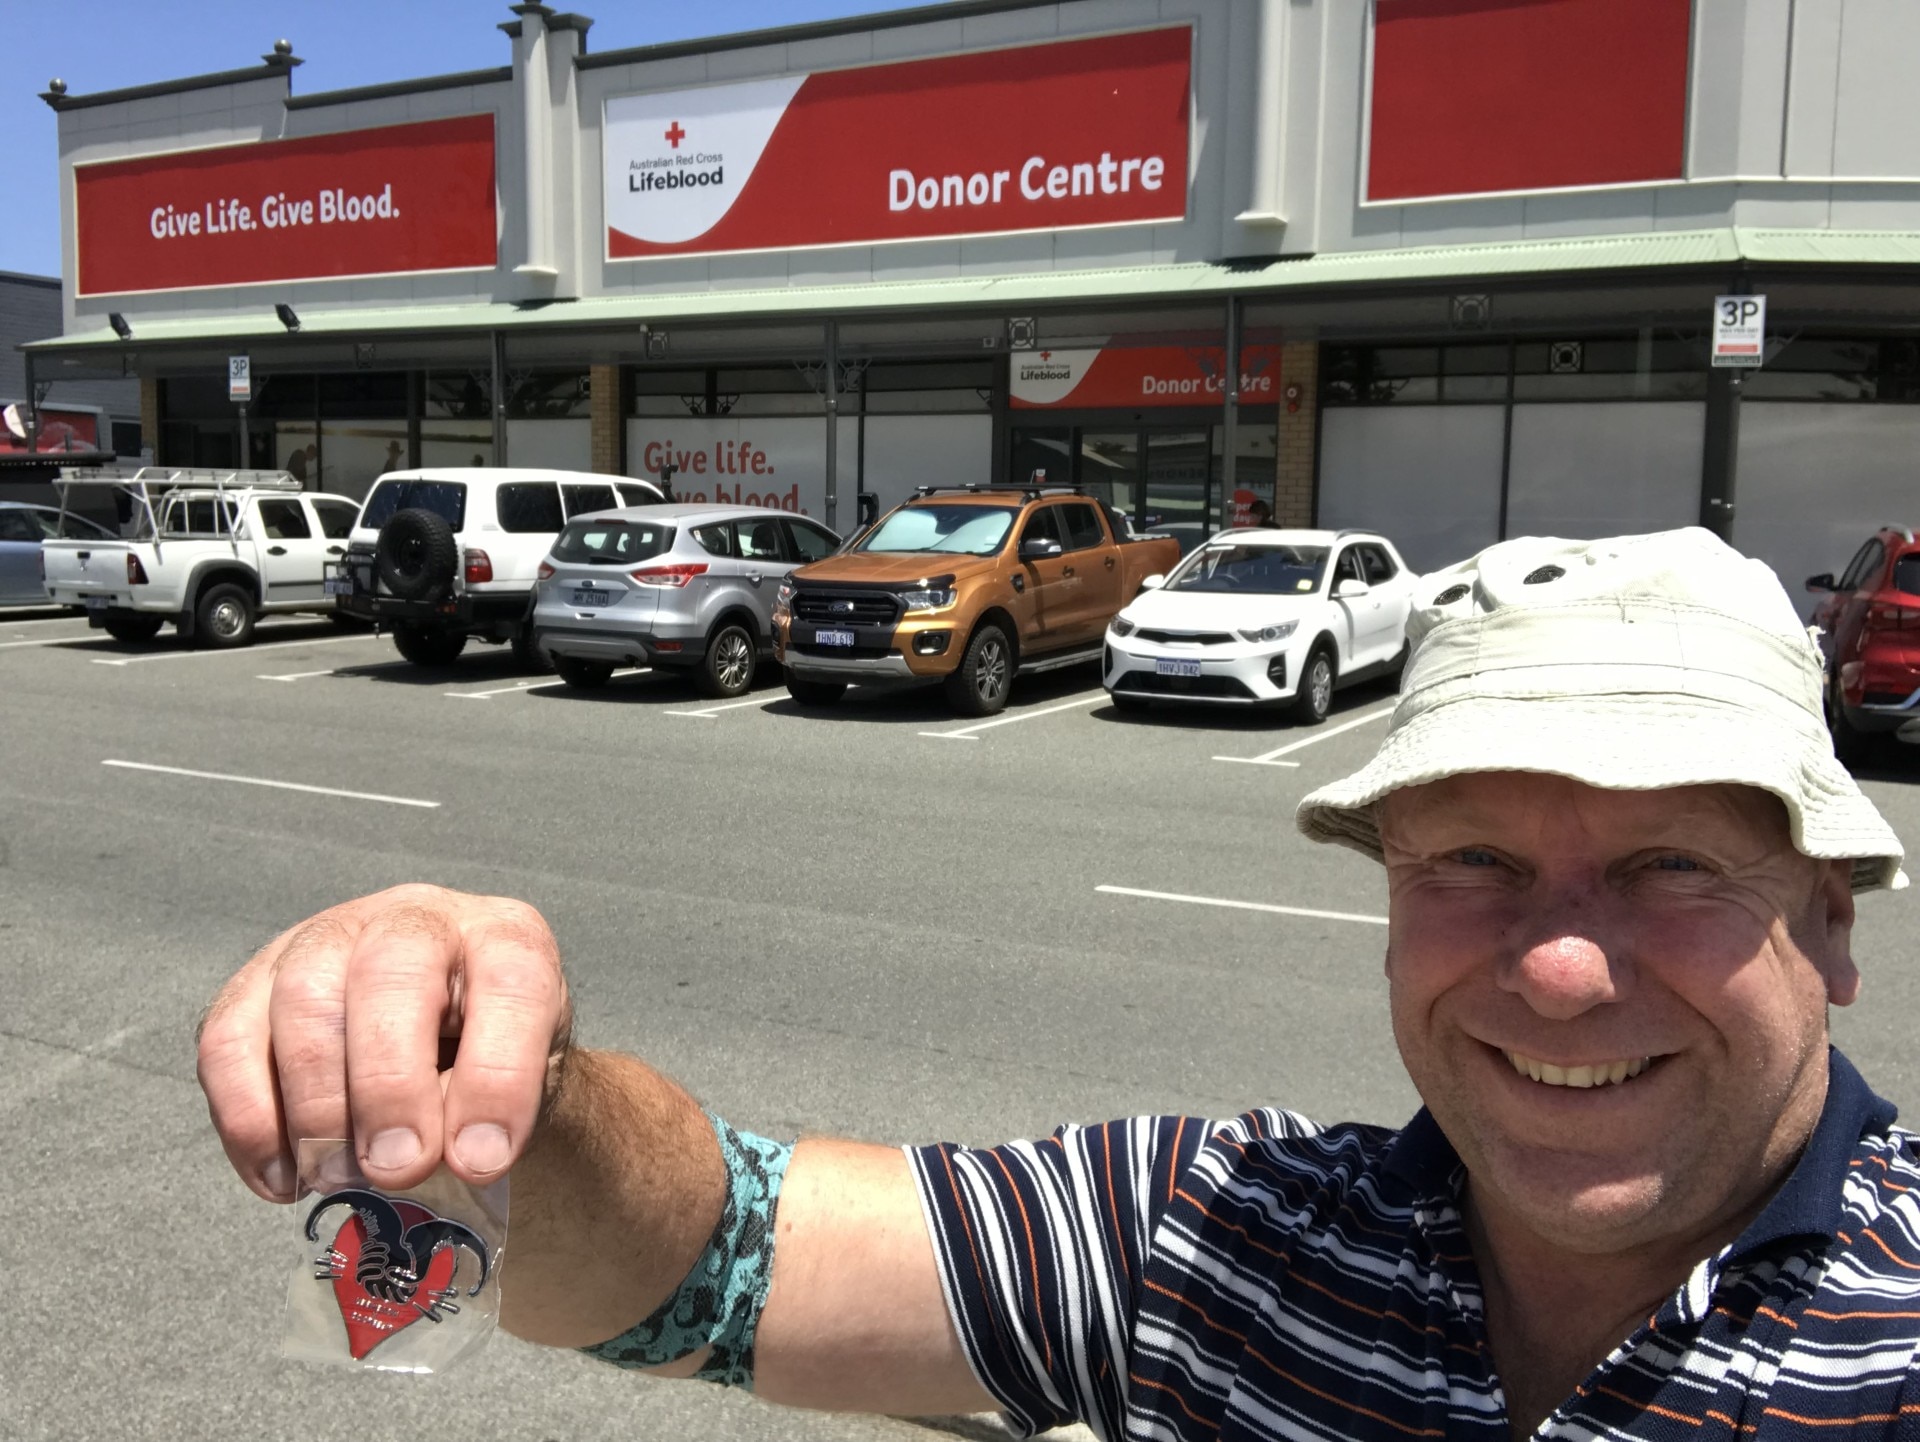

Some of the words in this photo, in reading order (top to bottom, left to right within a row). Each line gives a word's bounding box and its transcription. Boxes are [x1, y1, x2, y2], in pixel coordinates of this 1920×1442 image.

[629, 158, 674, 170] Australian
[676, 154, 694, 165] Red
[696, 152, 723, 164] Cross
[629, 166, 723, 192] Lifeblood
[889, 169, 1010, 211] Donor
[1020, 152, 1165, 200] Centre
[151, 204, 200, 239] Give
[206, 199, 257, 233] Life.
[261, 192, 313, 228] Give
[319, 184, 400, 223] Blood.
[1721, 301, 1759, 326] 3P
[232, 359, 248, 376] 3P
[1020, 370, 1070, 380] Lifeblood
[1142, 375, 1200, 394] Donor
[1205, 373, 1271, 392] Cetre
[644, 440, 707, 474] Give
[716, 440, 775, 475] life.
